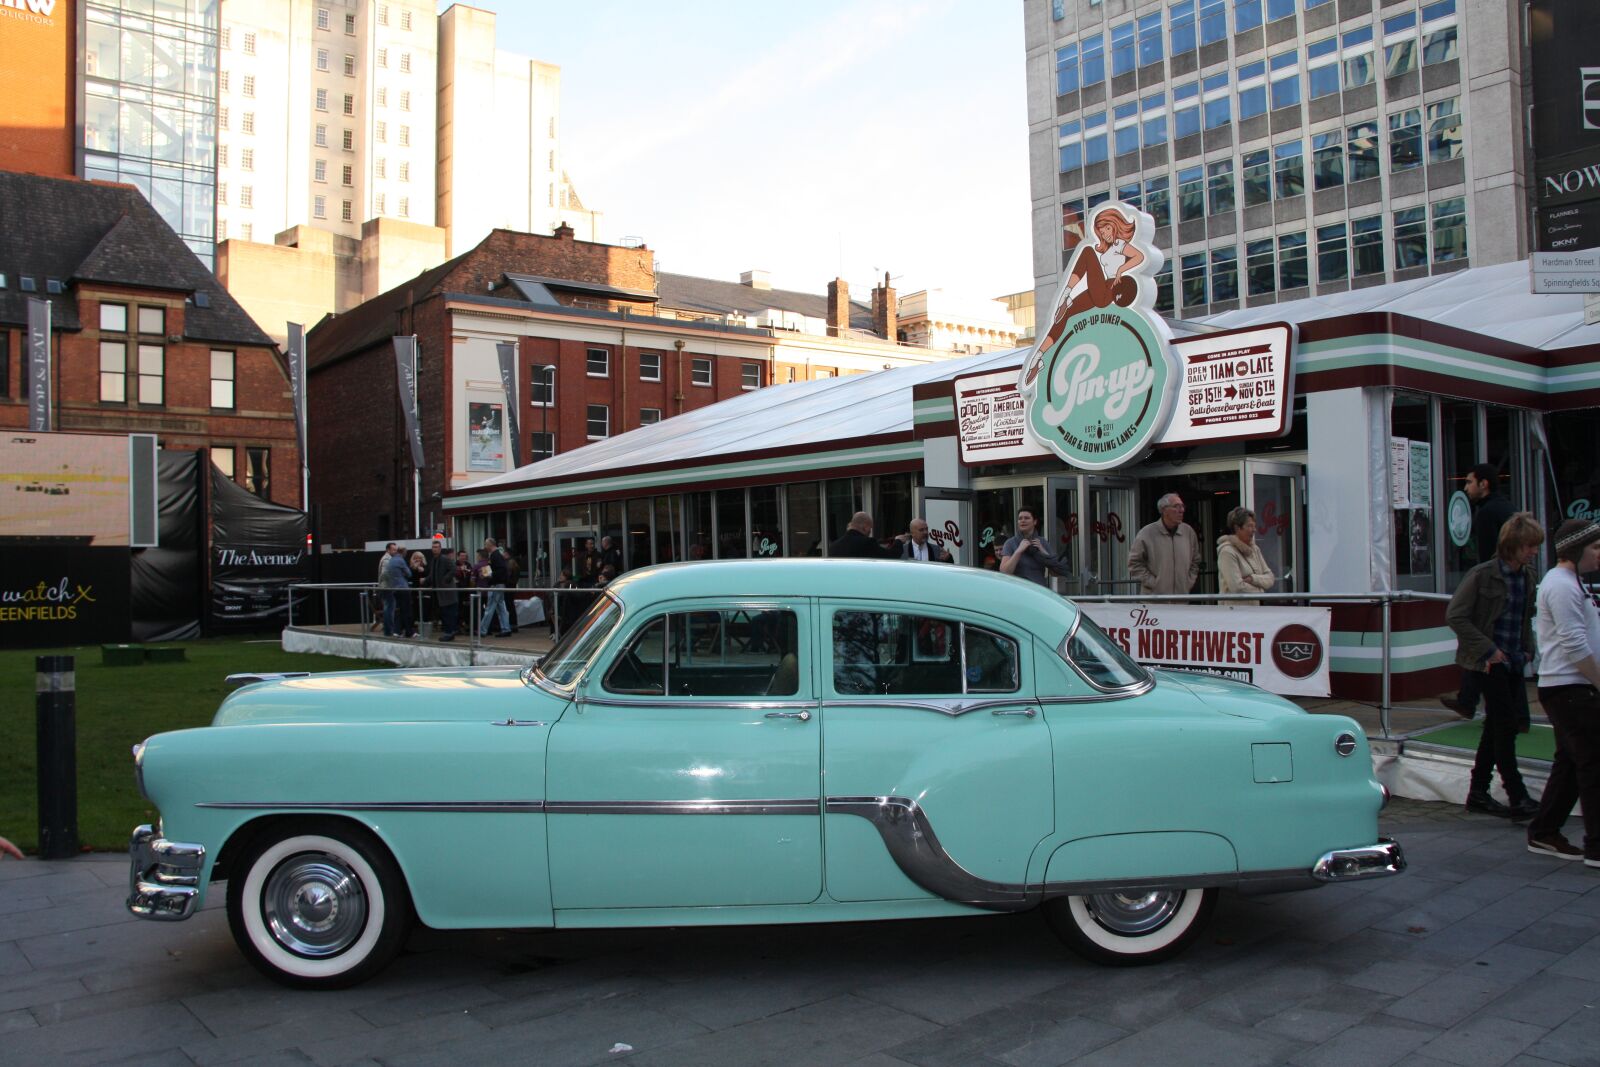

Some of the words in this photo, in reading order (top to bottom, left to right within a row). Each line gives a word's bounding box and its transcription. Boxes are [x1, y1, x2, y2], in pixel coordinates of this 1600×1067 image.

[1550, 209, 1579, 219] FLANNELS
[1552, 237, 1578, 247] DKNY
[1542, 258, 1572, 266] Hardman
[1575, 258, 1594, 266] Street
[1543, 278, 1589, 289] Spinningfields
[1074, 316, 1099, 333] POP-UP
[1101, 313, 1121, 326] DINER
[33, 327, 45, 363] EAT
[1188, 366, 1207, 376] OPEN
[1209, 361, 1234, 380] 11AM
[1250, 356, 1274, 374] LATE
[1188, 374, 1207, 383] DAILY
[1189, 394, 1203, 405] SEP
[1204, 387, 1222, 403] 15TH
[1239, 388, 1254, 399] NOV
[1256, 380, 1275, 397] 6TH
[993, 400, 1024, 412] AMERICAN
[1190, 407, 1206, 416] Balls
[1206, 405, 1224, 414] Booze
[1225, 403, 1249, 412] Burgers
[1250, 401, 1256, 409] &
[1256, 399, 1275, 408] Beats
[961, 415, 989, 431] Bowling
[1063, 431, 1077, 445] BAR
[1077, 440, 1082, 450] &
[1083, 440, 1116, 453] BOWLING
[1116, 424, 1137, 446] LANES
[219, 549, 246, 565] The
[2, 576, 75, 602] watch
[0, 605, 77, 620] EENFIELDS
[1130, 608, 1160, 628] The
[1138, 628, 1265, 664] NORTHWEST
